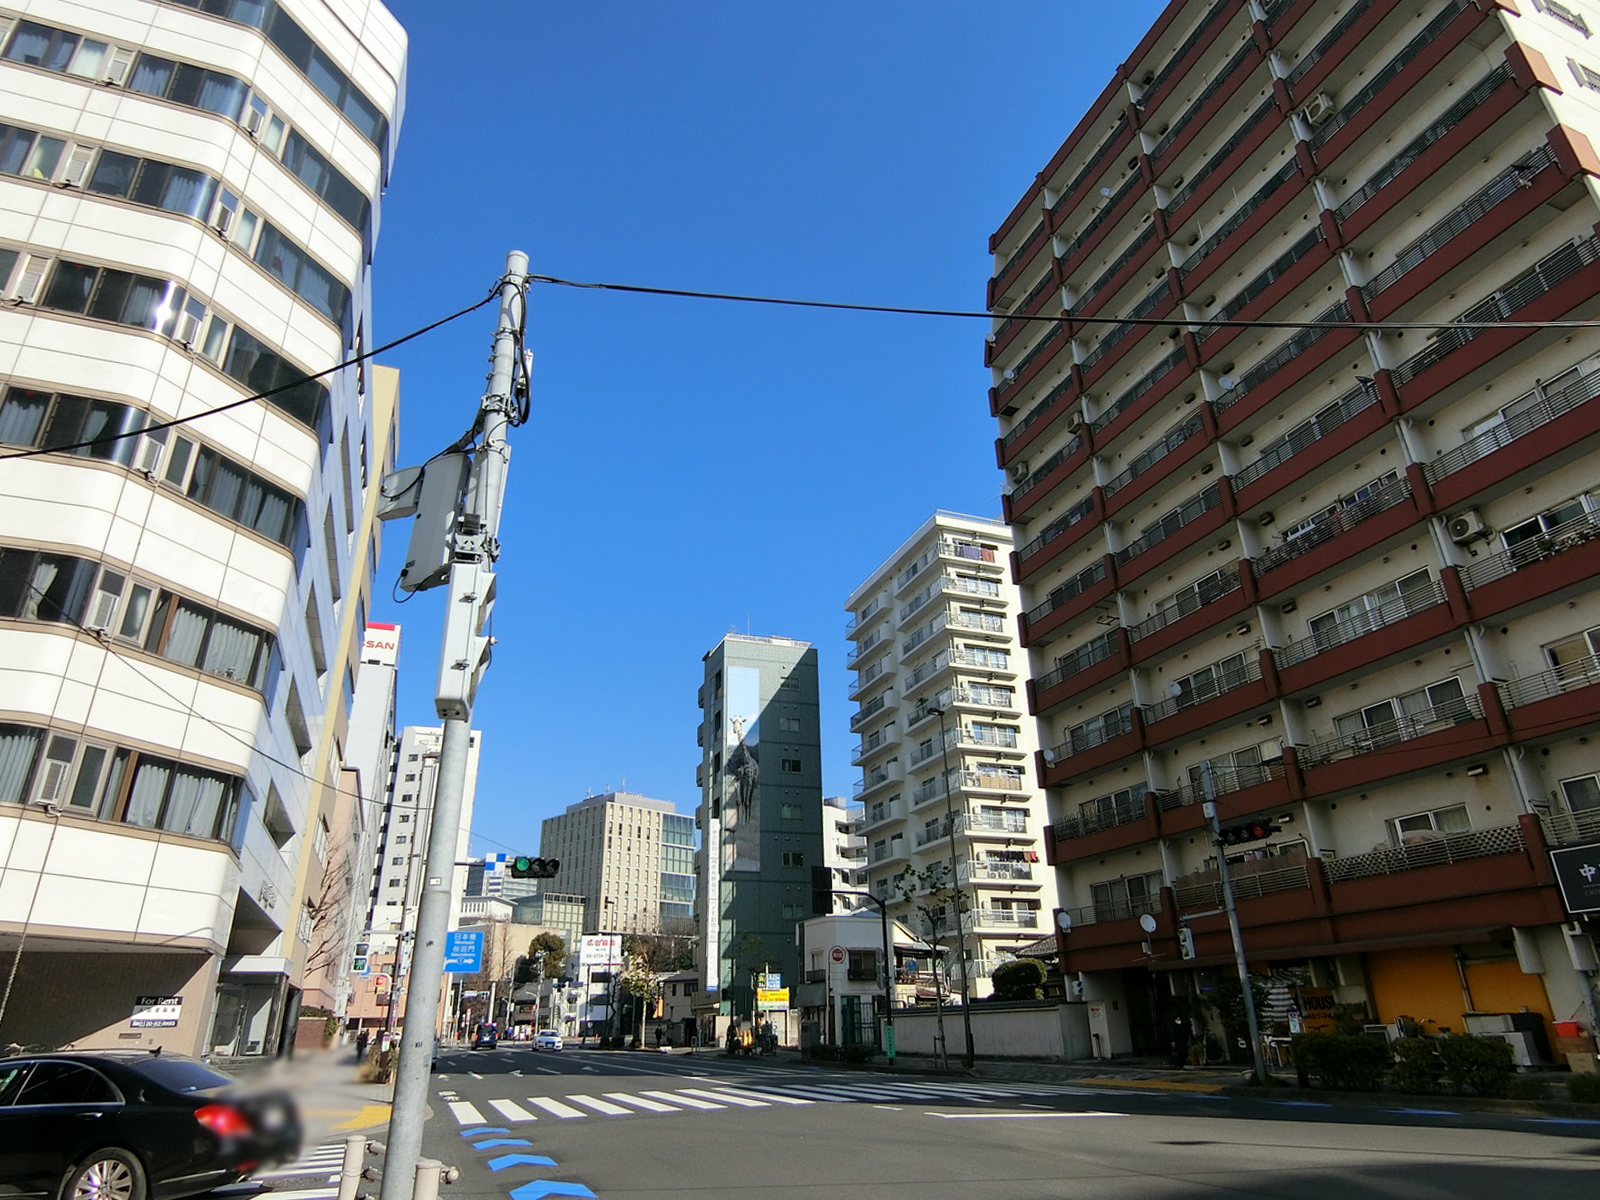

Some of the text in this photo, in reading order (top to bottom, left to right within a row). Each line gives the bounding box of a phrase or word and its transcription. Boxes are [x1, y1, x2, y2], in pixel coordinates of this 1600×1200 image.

[362, 640, 395, 650] SAN
[454, 932, 476, 941] 日本橋
[453, 945, 475, 953] 桜田門
[141, 997, 155, 1005] For
[1303, 994, 1335, 1010] HOUS
